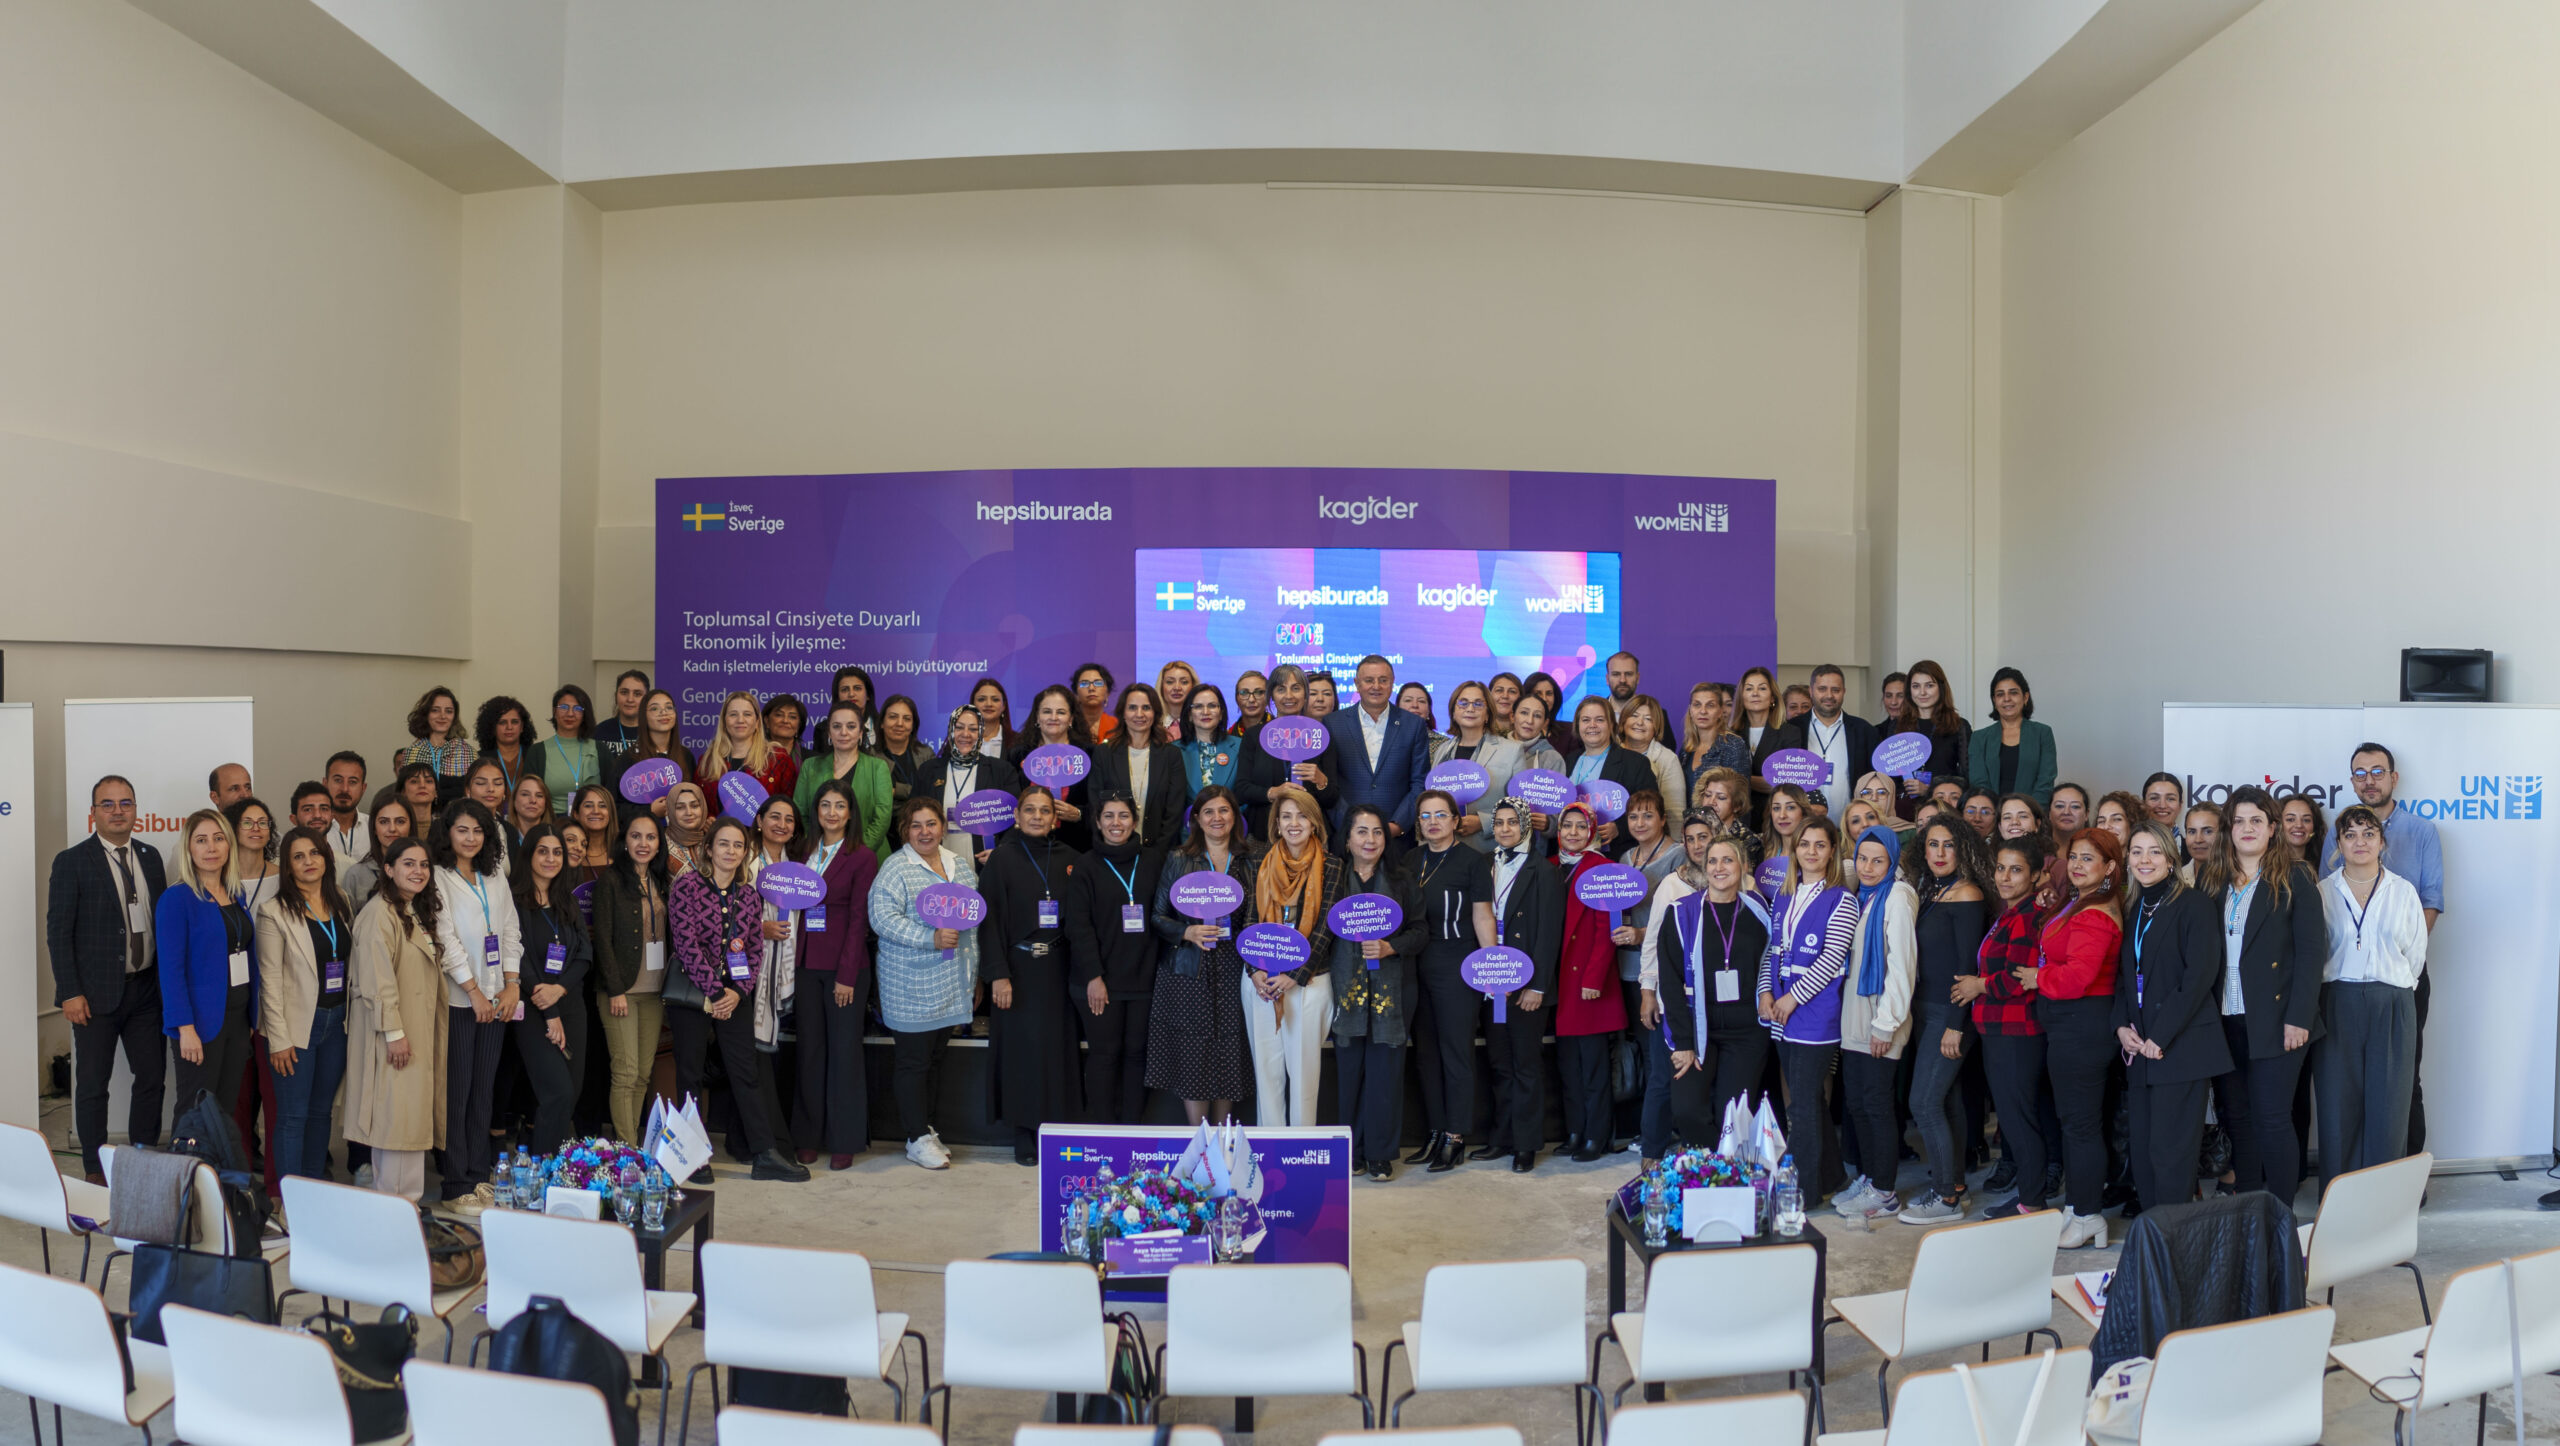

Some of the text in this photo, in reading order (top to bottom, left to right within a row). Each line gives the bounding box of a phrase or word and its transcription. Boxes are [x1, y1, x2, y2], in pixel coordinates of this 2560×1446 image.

[729, 500, 753, 514] İsveç
[977, 501, 1112, 525] hepsiburada
[1678, 503, 1702, 517] UN
[729, 515, 785, 534] Sverige
[1635, 516, 1703, 532] WOMEN
[1278, 586, 1389, 609] hepsiburada
[1561, 585, 1582, 598] UN
[1197, 596, 1245, 615] Sverige
[1525, 598, 1583, 613] WOMEN
[683, 610, 920, 631] Toplumsal Cinsiyete Duyarlı
[1276, 623, 1315, 645] EXPO
[683, 631, 846, 653] Ekonomik İyileşme:
[1275, 653, 1324, 665] Toplumsal
[683, 660, 720, 672] Kadın
[723, 660, 811, 675] işletmeleriyle
[897, 659, 988, 676] büyütüyoruz!
[1533, 775, 1554, 784] Kadın
[2461, 776, 2499, 796] UN
[765, 872, 793, 884] Kadının
[1592, 873, 1628, 883] Toplumsal
[761, 881, 820, 898] Geleceğin Temeli
[1180, 886, 1207, 894] Kadının
[1583, 881, 1638, 891] Cinsiyete Duyarlı
[1177, 896, 1212, 905] Geleceğin
[1580, 891, 1615, 900] Ekonomik
[1353, 901, 1376, 910] Kadın
[1338, 907, 1392, 920] işletmeleriyle
[1346, 915, 1387, 926] ekonomiyi
[1342, 922, 1392, 935] büyütüyoruz!
[1255, 932, 1291, 944] Toplumsal
[1244, 939, 1301, 953] Cinsiyete Duyarlı
[1241, 947, 1305, 962] Ekonomik İyileşme
[1486, 953, 1508, 961] Kadın
[1472, 960, 1523, 971] işletmeleriyle
[1477, 968, 1517, 977] ekonomiyi
[1473, 976, 1522, 986] büyütüyoruz!
[1282, 1156, 1317, 1165] WOMEN
